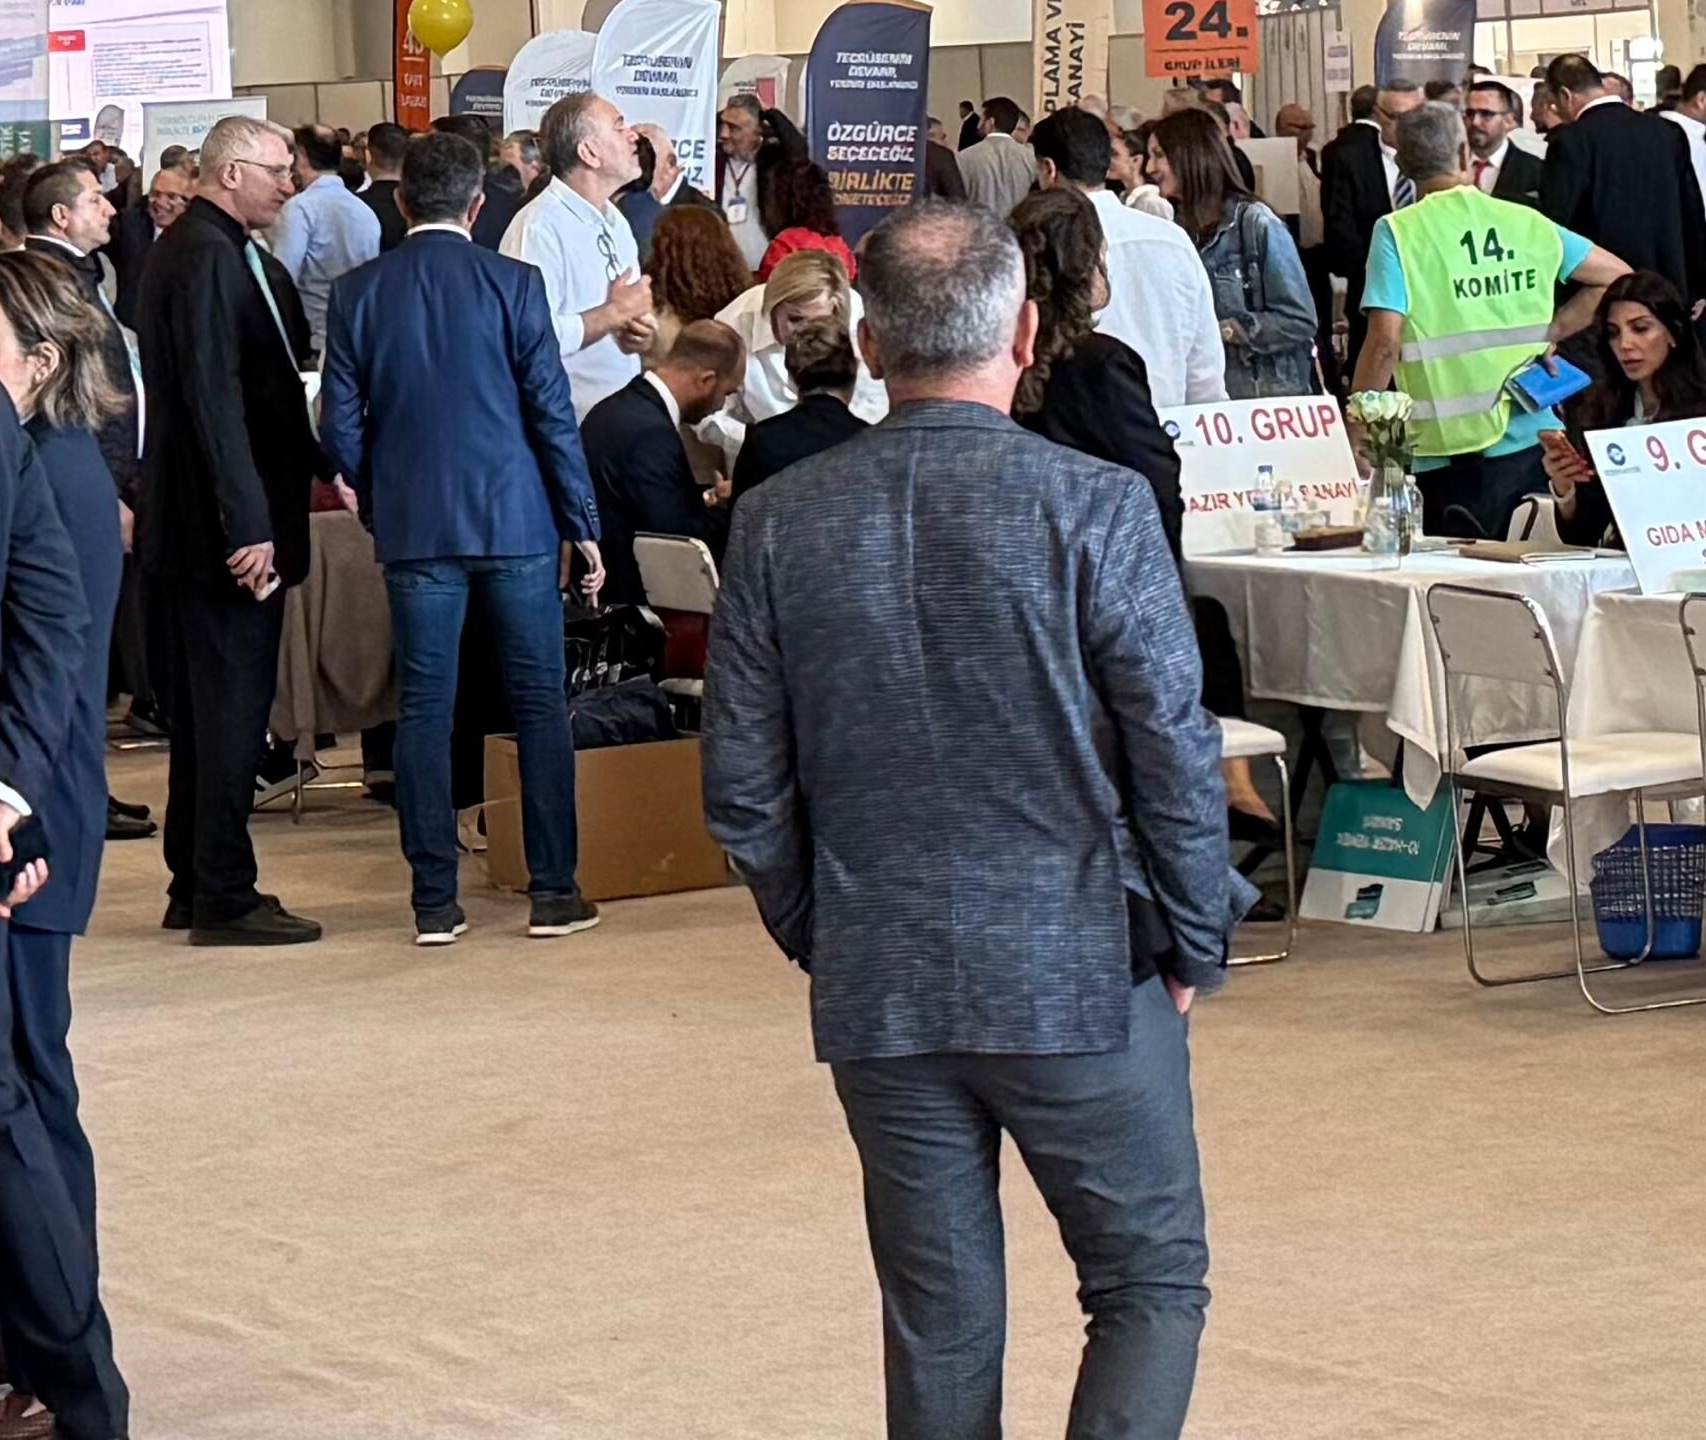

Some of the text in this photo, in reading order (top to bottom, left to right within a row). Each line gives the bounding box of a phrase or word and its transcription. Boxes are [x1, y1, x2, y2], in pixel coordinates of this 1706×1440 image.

[1065, 22, 1086, 107] ANAYİ
[827, 120, 919, 143] ÖZGÜRCE
[1459, 227, 1514, 265] 14.
[1453, 268, 1536, 299] KOMİTE
[1195, 404, 1336, 446] 10. GRUP
[1646, 435, 1681, 472] 9.
[1189, 491, 1231, 512] AZIR
[1646, 523, 1695, 547] GIDA
